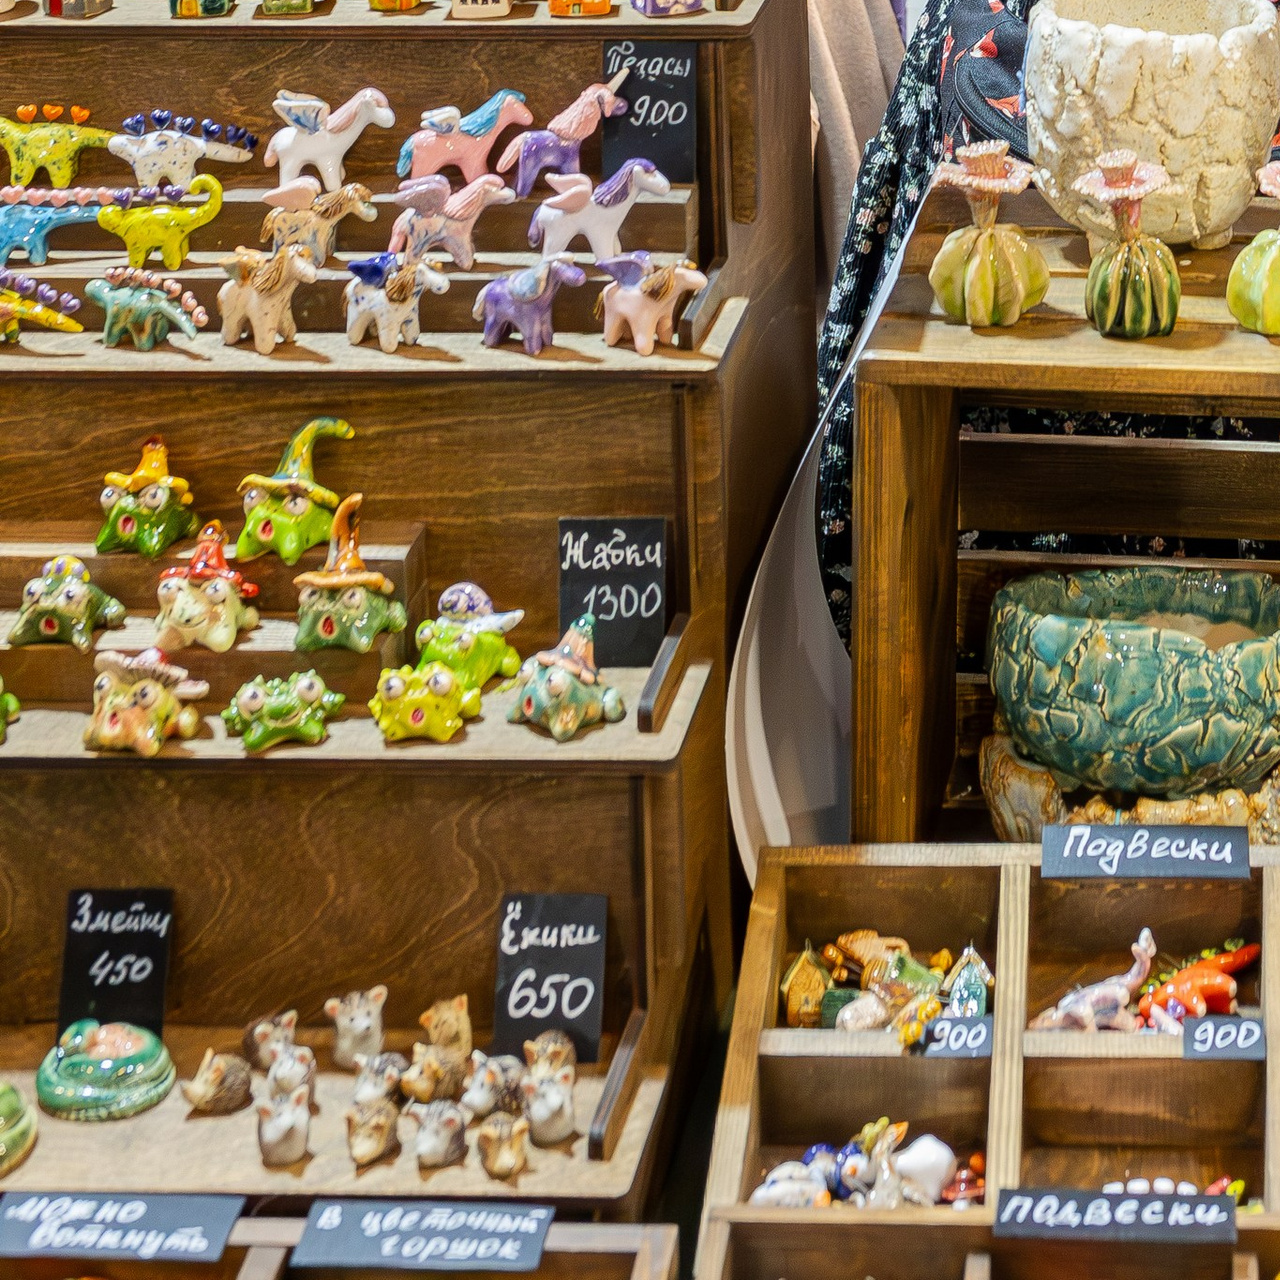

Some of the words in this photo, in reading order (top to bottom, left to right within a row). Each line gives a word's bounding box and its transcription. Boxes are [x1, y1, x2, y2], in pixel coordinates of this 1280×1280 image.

[561, 528, 662, 570] Жабки
[583, 582, 662, 621] 1300
[1063, 825, 1233, 875] Подвески
[70, 892, 172, 938] Змейки
[500, 900, 601, 956] Ёжики
[88, 949, 154, 987] 450
[507, 967, 595, 1019] 650
[929, 1020, 987, 1052] 900
[1193, 1020, 1262, 1053] 900
[360, 1206, 548, 1237] цветочный
